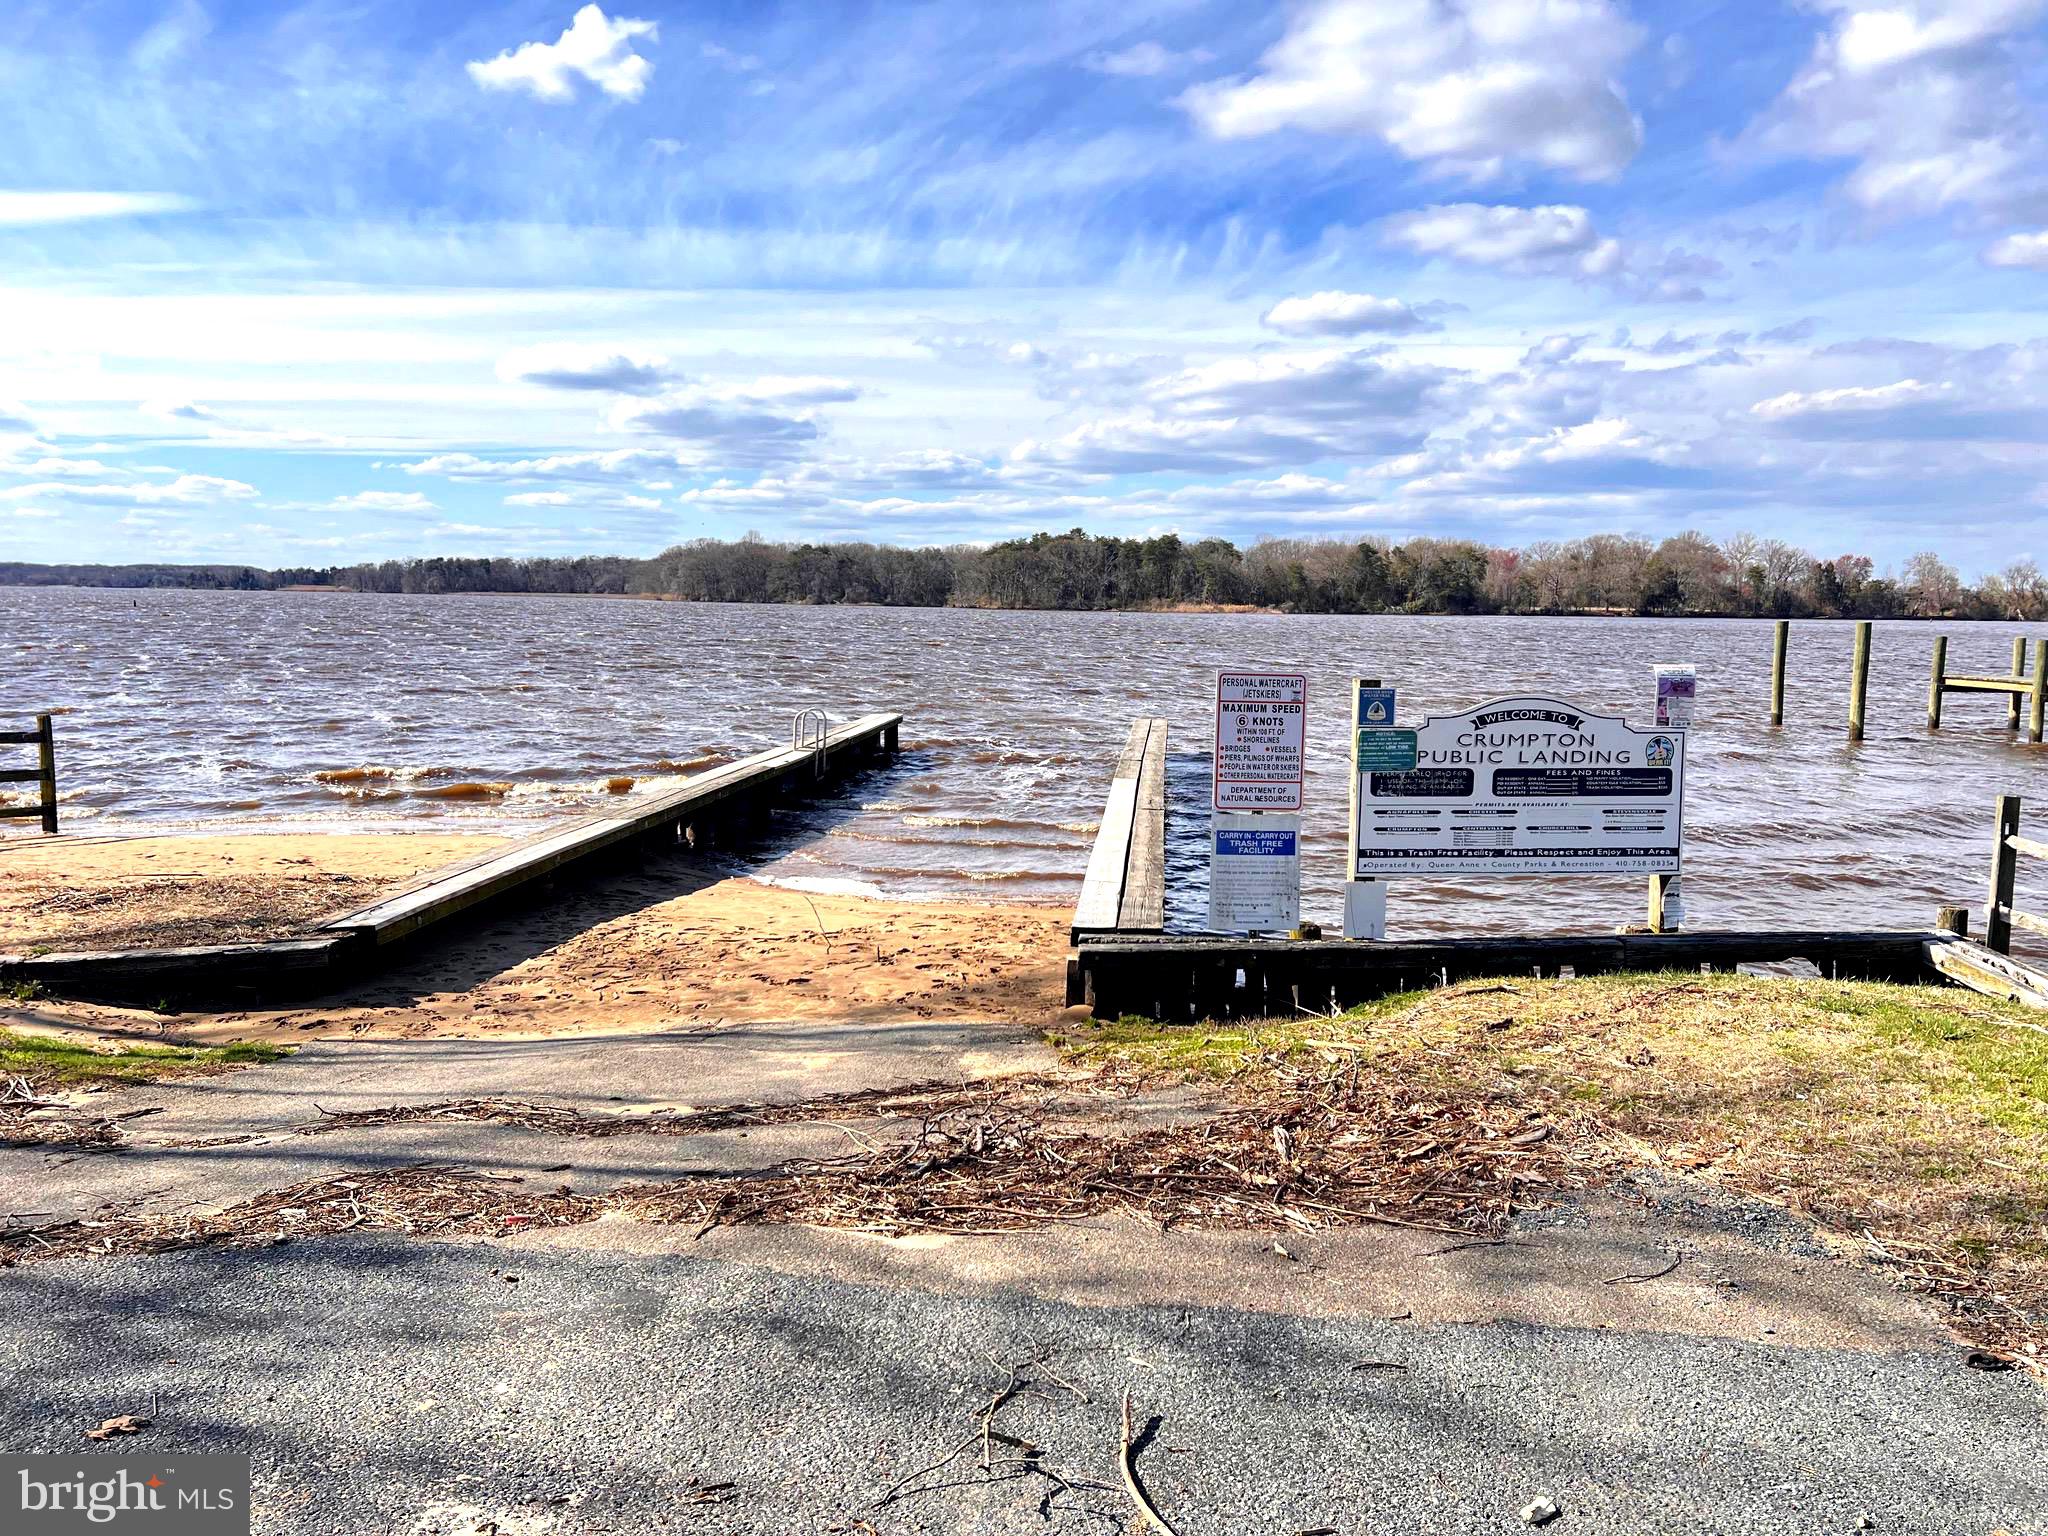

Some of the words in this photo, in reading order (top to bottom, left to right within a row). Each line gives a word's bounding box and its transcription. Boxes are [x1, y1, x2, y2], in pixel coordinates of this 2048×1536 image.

[1222, 678, 1257, 688] PERSONAL
[1259, 680, 1302, 688] WATERCRAFT
[1242, 689, 1282, 699] (JETSKIERS)
[1222, 704, 1268, 712] MAXIMUM
[1272, 704, 1301, 714] SPEED
[1484, 710, 1547, 722] WELCOME
[1552, 712, 1568, 722] TO
[1238, 717, 1246, 726] 6
[1252, 718, 1284, 726] KNOTS
[1457, 733, 1595, 748] CRUMPTON
[1418, 750, 1503, 764] PUBLIC
[1518, 750, 1632, 764] LANDING
[1537, 849, 1574, 857] Respect
[1597, 848, 1622, 857] Enjoy
